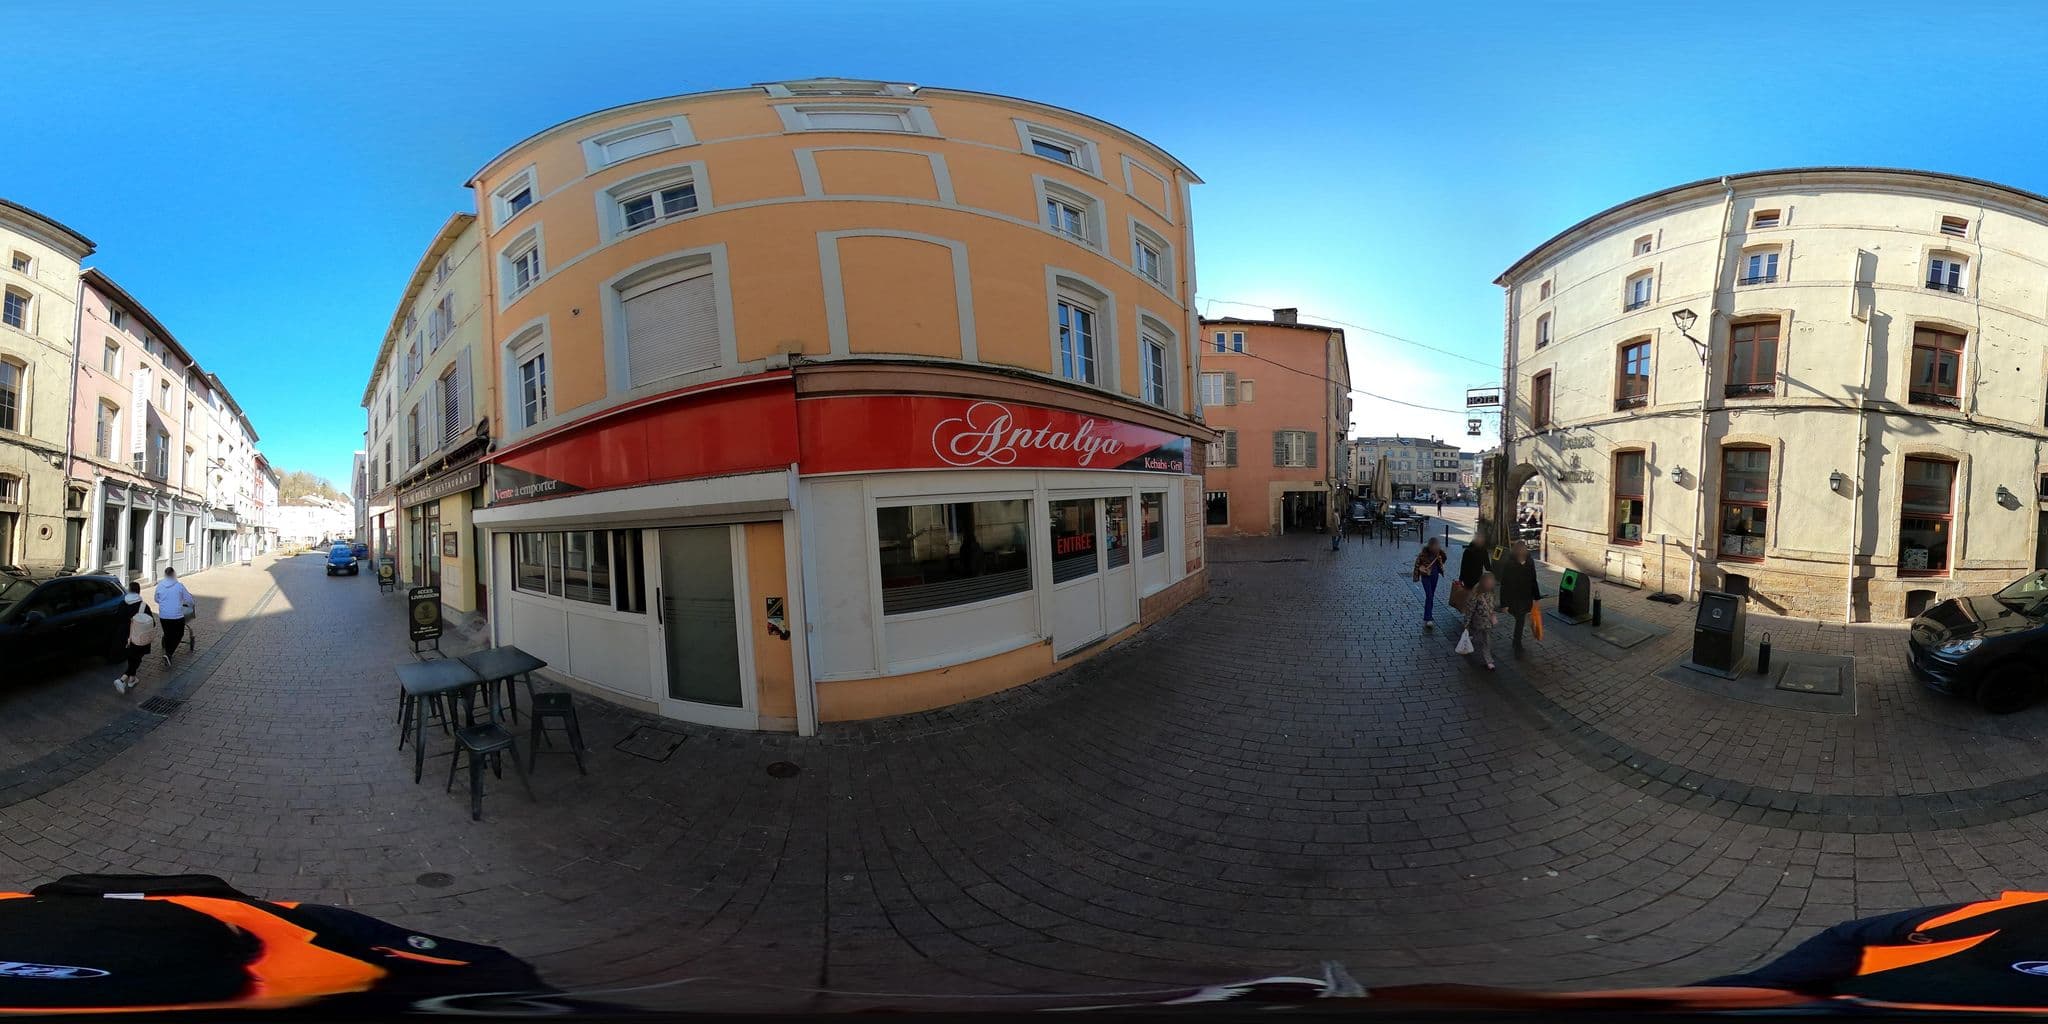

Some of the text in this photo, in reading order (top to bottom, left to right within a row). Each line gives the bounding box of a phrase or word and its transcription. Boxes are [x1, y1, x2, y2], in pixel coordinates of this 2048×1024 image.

[1468, 395, 1498, 405] HOTEL
[932, 401, 1124, 467] Antalya
[1144, 457, 1168, 469] Kebabs
[1170, 460, 1182, 471] Grill
[435, 472, 472, 493] RESTAURANT
[496, 489, 513, 499] Vente
[520, 480, 558, 497] emporter
